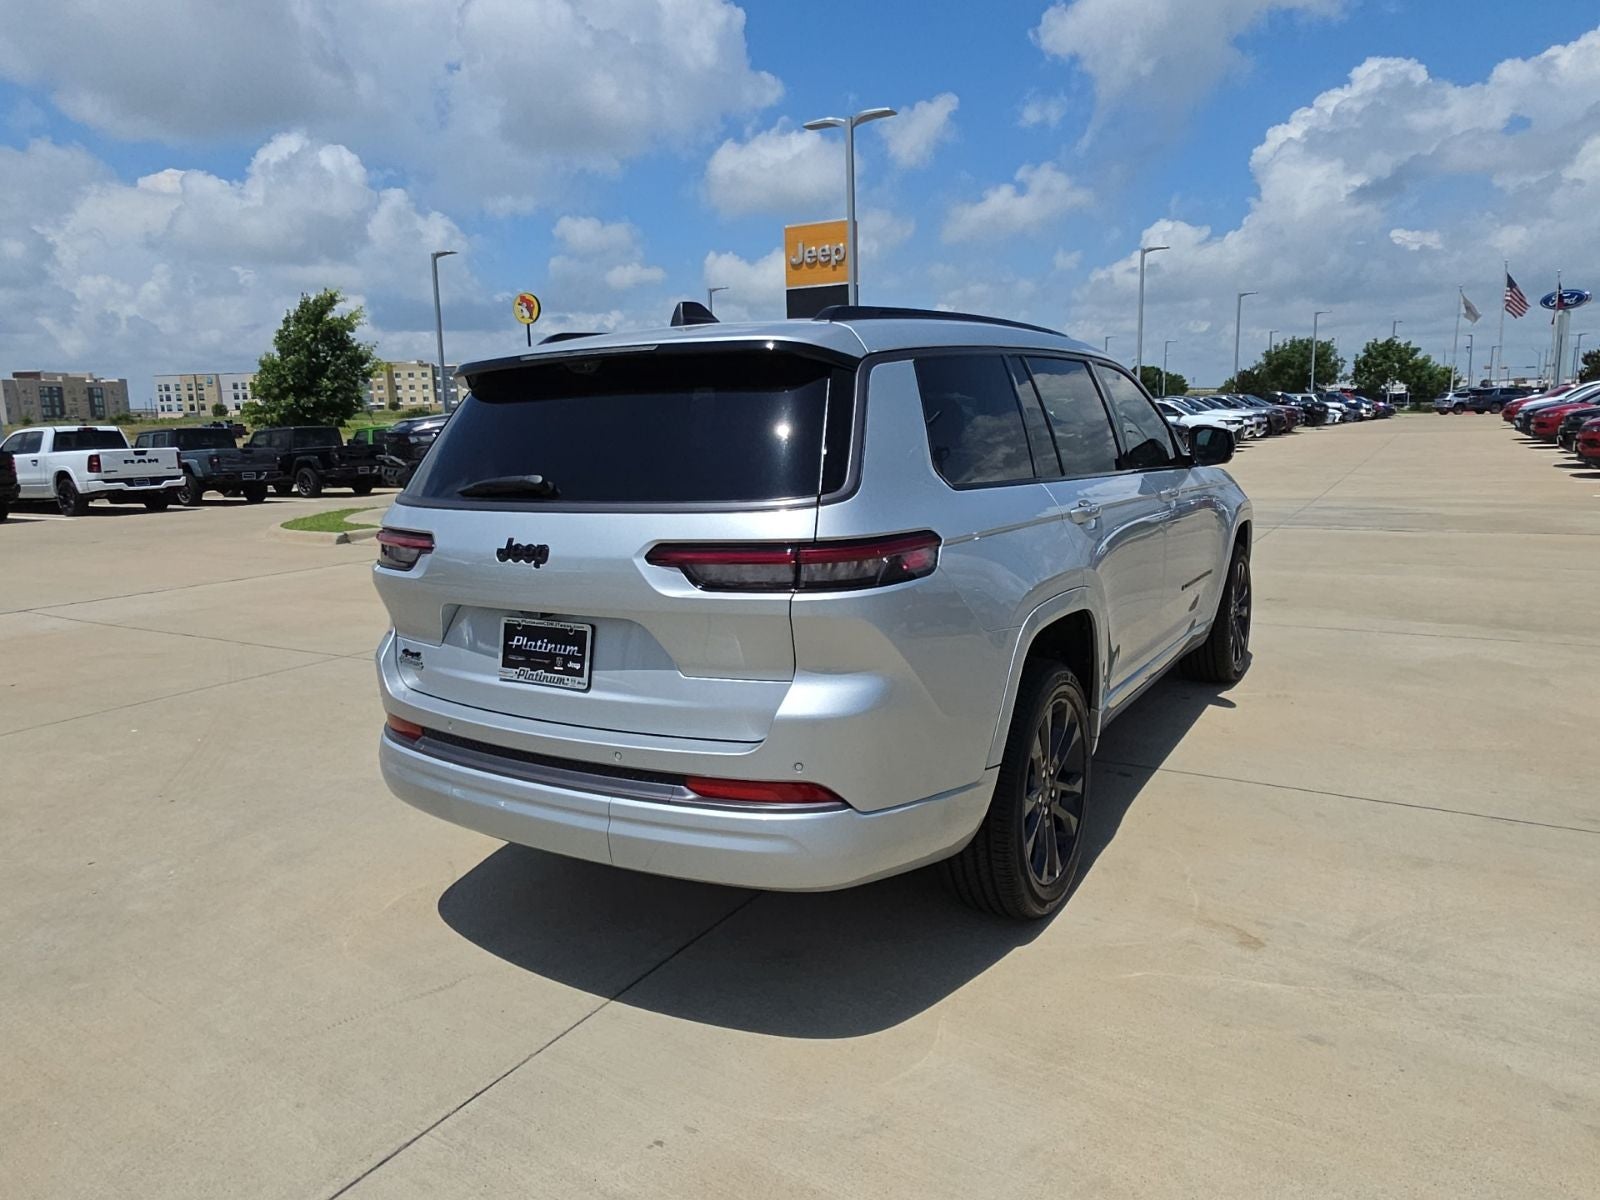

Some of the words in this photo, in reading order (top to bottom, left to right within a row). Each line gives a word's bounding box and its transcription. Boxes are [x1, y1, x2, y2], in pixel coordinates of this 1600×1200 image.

[790, 241, 846, 266] Jeep
[1548, 293, 1578, 306] Frd
[496, 537, 550, 569] Jeep
[508, 635, 582, 657] Platinum
[517, 668, 569, 686] Platinum
